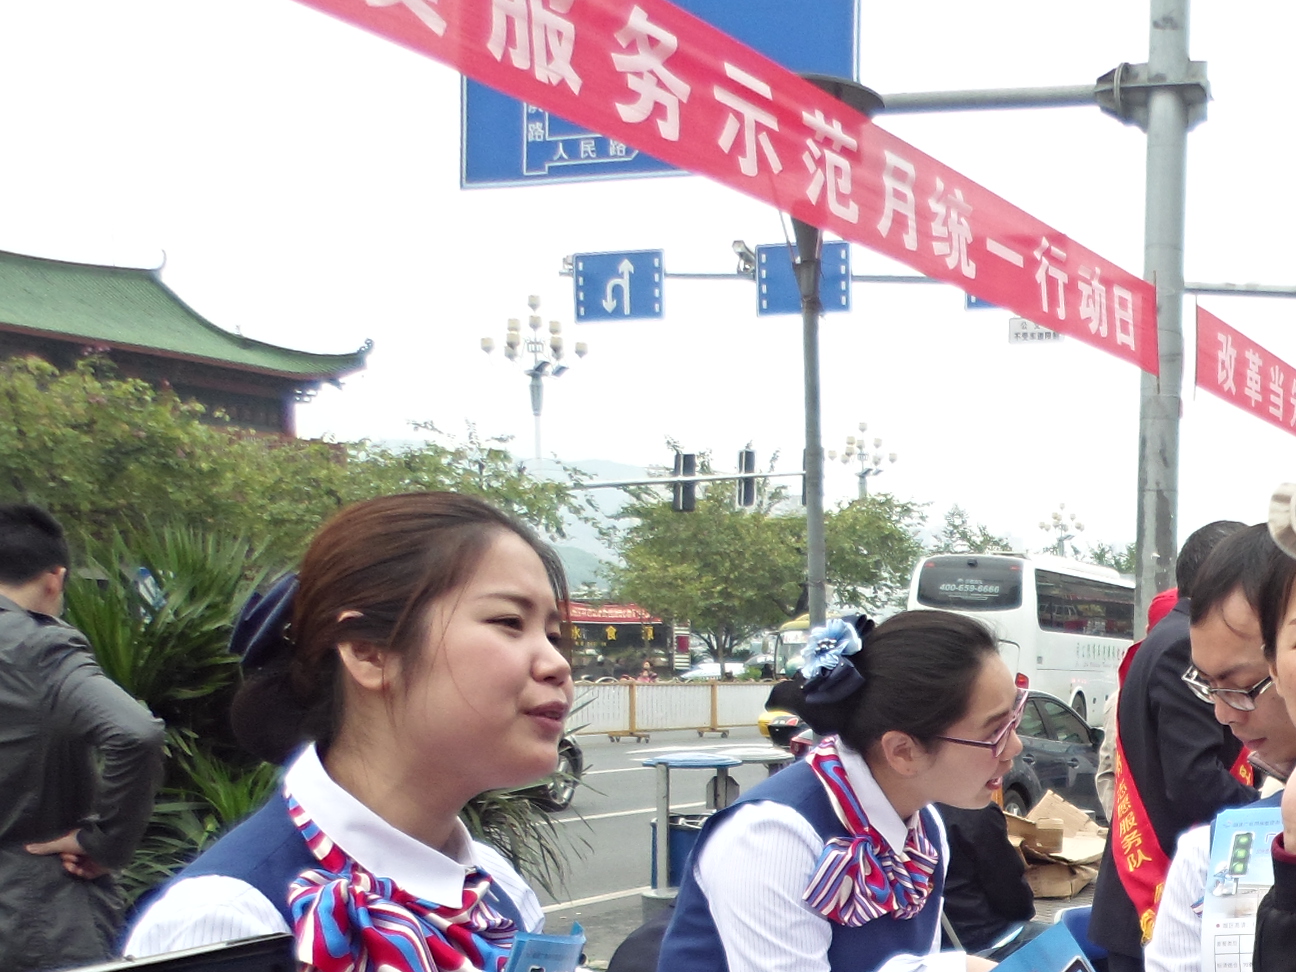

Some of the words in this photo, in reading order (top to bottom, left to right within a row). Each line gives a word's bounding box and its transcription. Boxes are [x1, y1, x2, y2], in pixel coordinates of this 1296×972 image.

[364, 0, 1136, 354] 服务示范月统一行动日
[553, 139, 626, 161] 人民路
